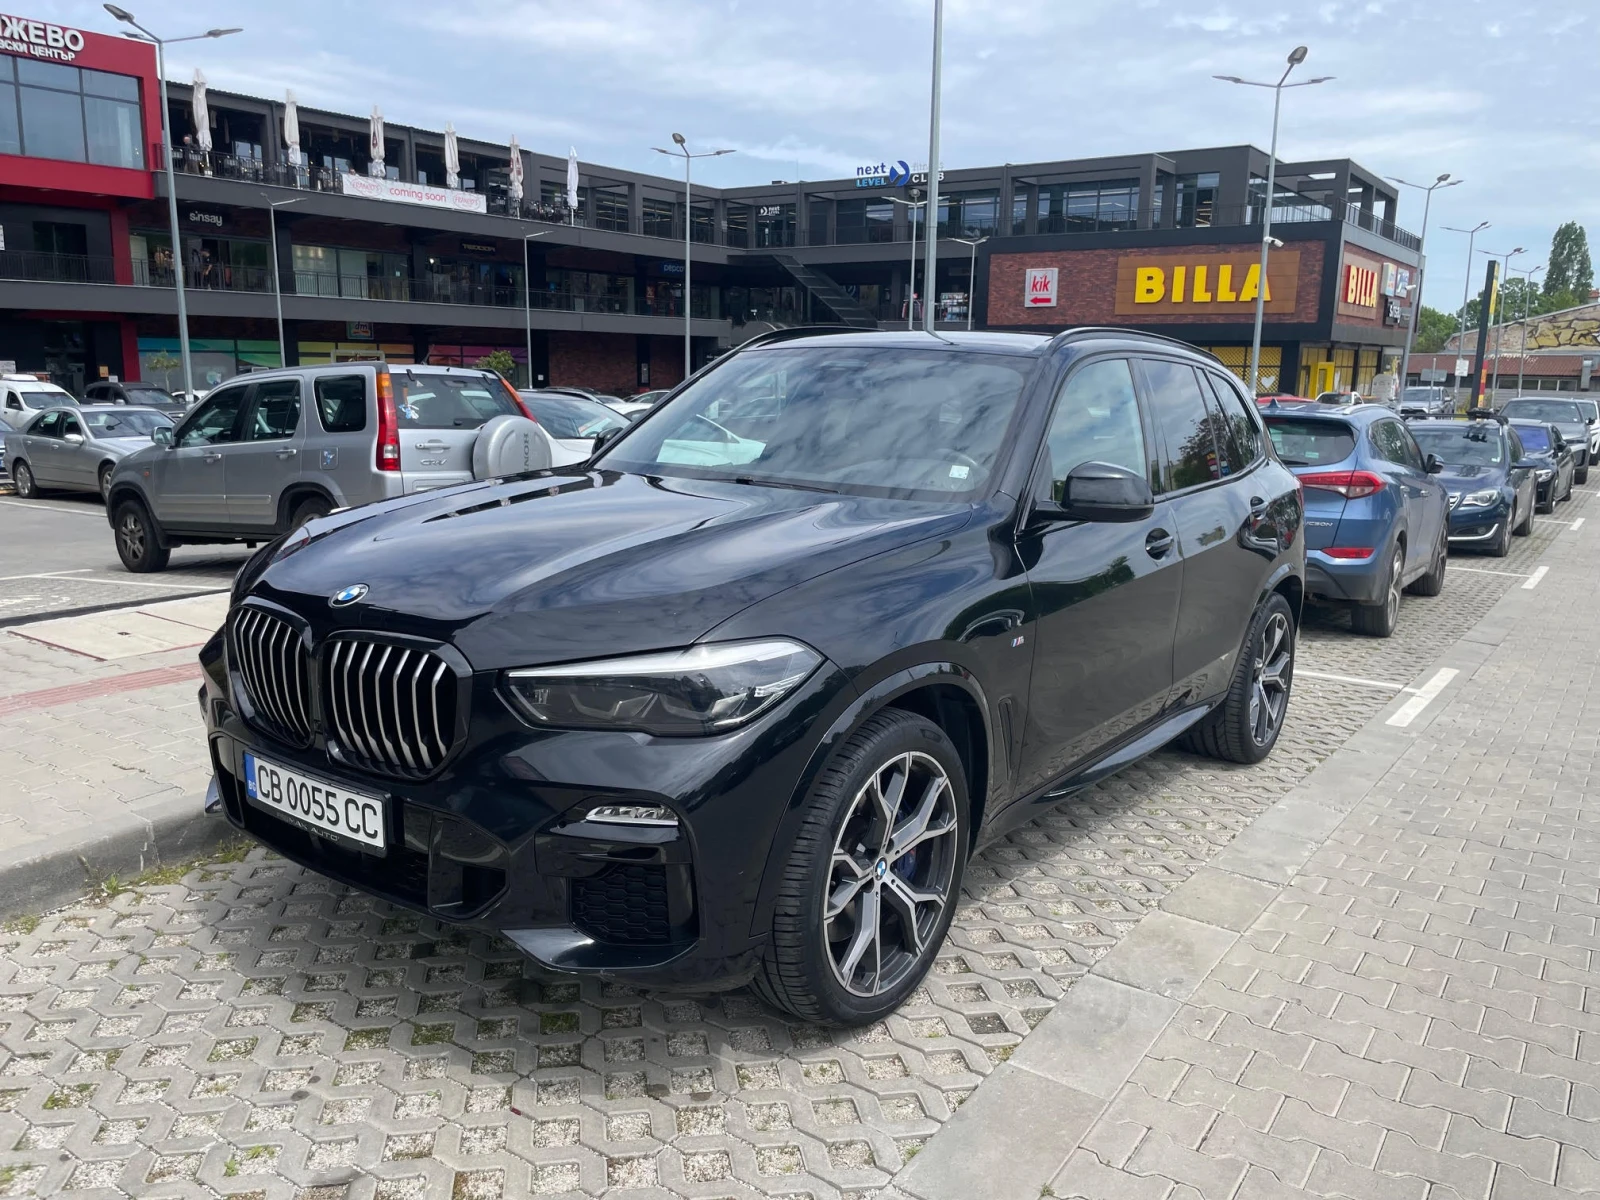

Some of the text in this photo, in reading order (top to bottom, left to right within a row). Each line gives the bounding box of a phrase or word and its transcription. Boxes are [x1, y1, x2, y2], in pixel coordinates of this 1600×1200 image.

[0, 14, 85, 52] ЖЕВО
[29, 44, 76, 61] ЦЕНТЪР
[856, 162, 886, 176] next
[856, 177, 887, 188] LEVEL
[912, 172, 945, 183] CLB
[389, 187, 447, 203] coming soon
[190, 211, 223, 227] sinsay
[1134, 263, 1272, 304] BILLA
[1345, 264, 1378, 308] BILLA
[355, 321, 368, 331] dm
[523, 432, 531, 472] HON
[248, 779, 257, 792] BG
[257, 764, 379, 840] CB 0055 CC
[310, 827, 338, 841] AUTO
